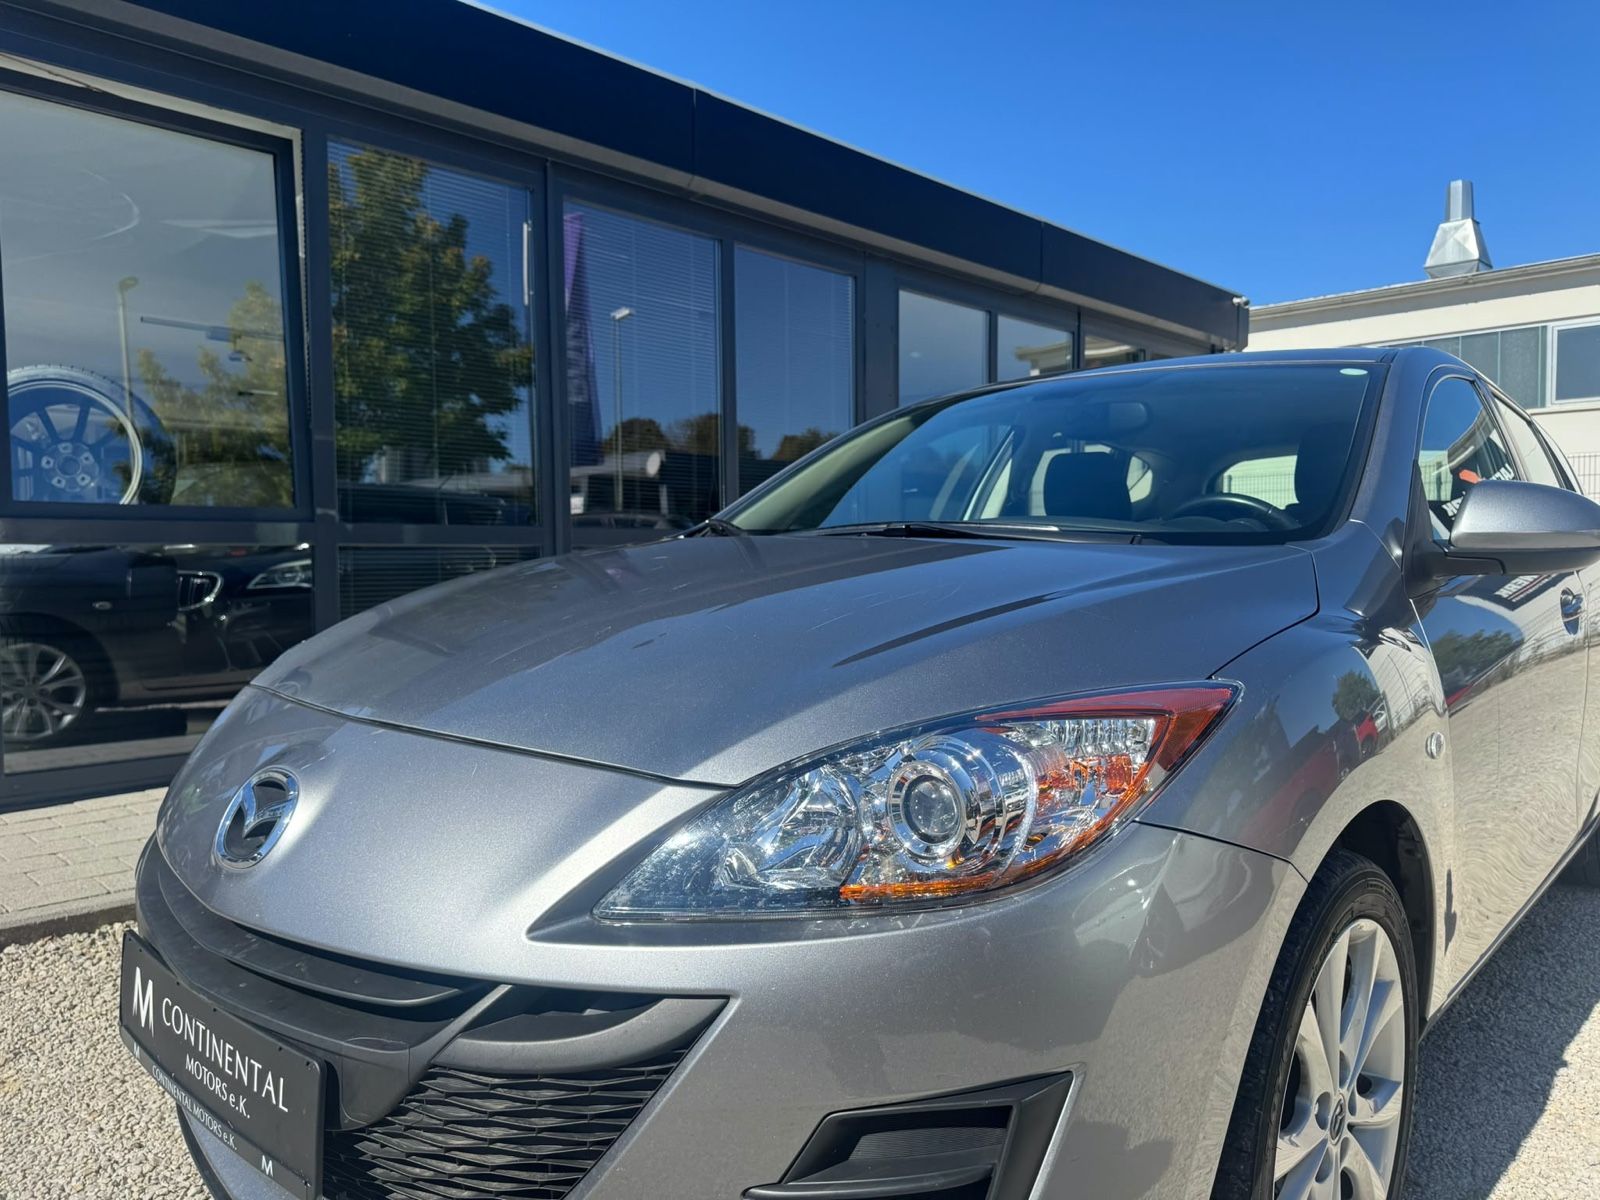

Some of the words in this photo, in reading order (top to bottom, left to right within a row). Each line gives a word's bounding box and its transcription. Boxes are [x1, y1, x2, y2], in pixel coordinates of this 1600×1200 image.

[162, 997, 289, 1113] CONTINENTAL
[185, 1053, 228, 1101] MOTORS
[229, 1093, 250, 1119] e.K.
[152, 1064, 193, 1112] CONTINENTAL
[192, 1103, 222, 1138] MOTORS
